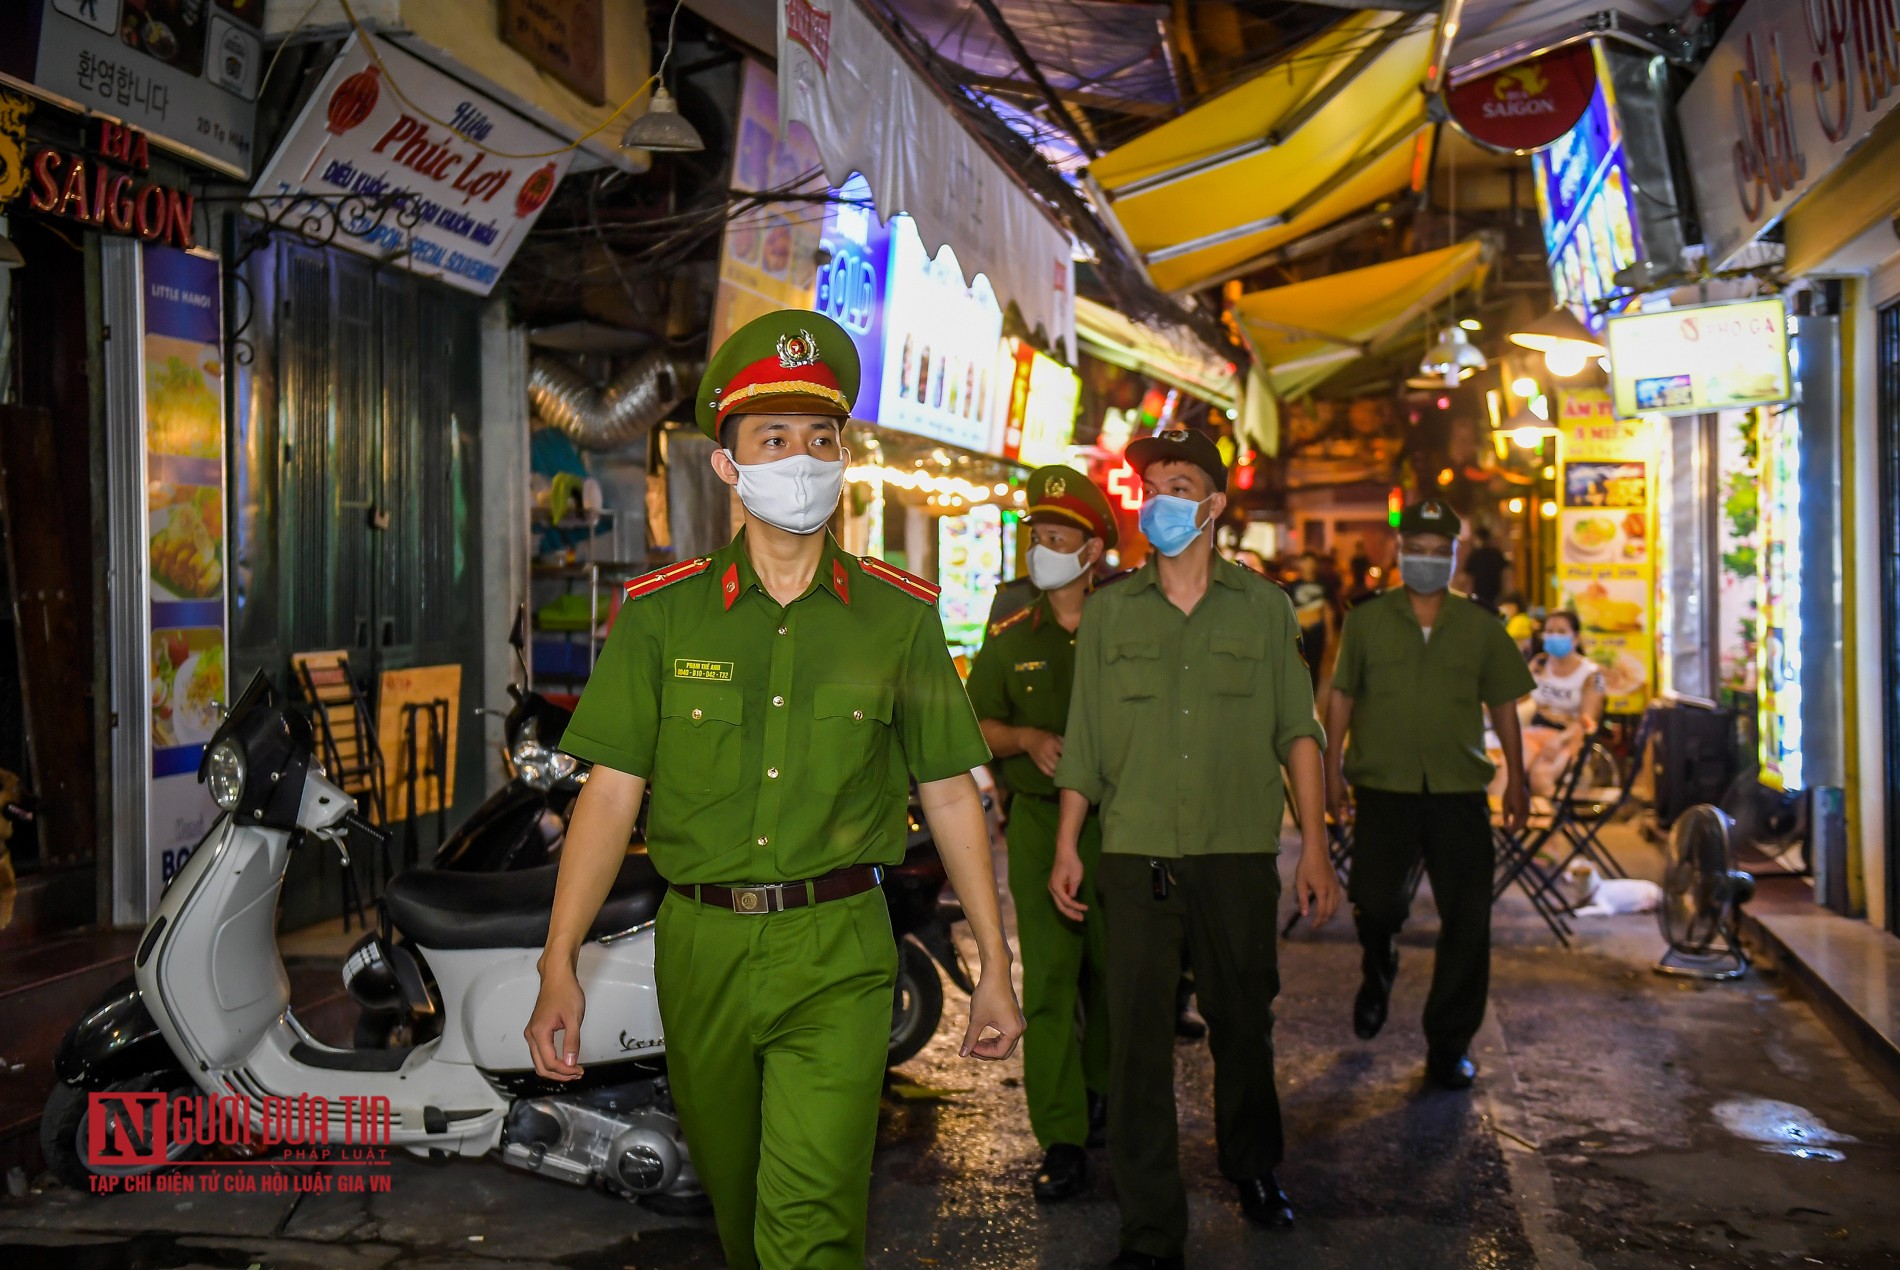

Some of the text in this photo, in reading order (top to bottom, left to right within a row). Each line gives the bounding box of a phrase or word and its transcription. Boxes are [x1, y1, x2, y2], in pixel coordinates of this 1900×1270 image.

[76, 50, 170, 122] 환영합니다
[1482, 98, 1555, 118] SAIGON
[101, 120, 150, 170] BIA
[371, 113, 513, 207] Phúc Lợi
[31, 149, 196, 249] SAIGON
[151, 283, 180, 302] LITTLE
